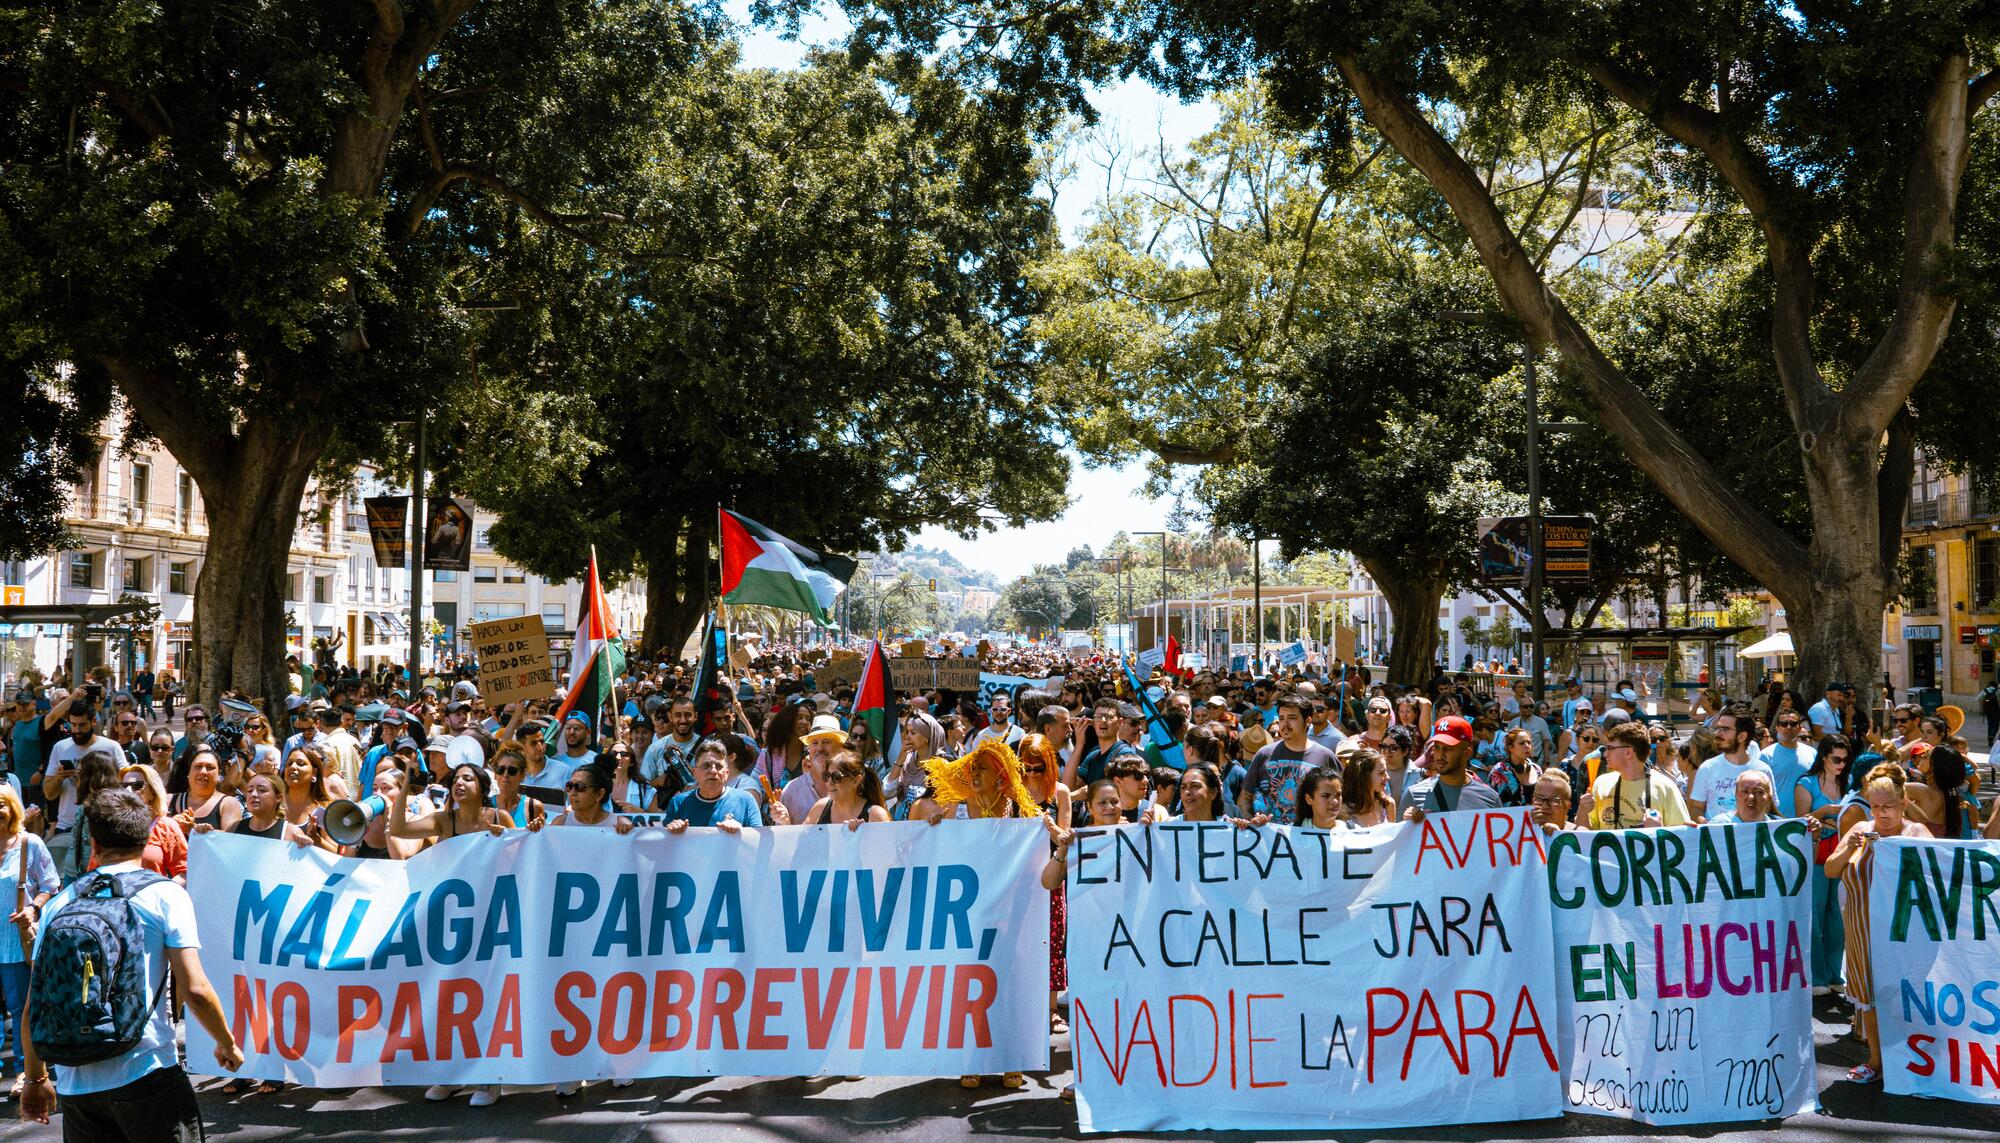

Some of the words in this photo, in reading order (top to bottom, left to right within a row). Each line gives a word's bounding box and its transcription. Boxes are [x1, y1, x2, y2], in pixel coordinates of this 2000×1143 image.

[1545, 532, 1589, 540] COSTURAS
[477, 625, 504, 639] HACIA
[508, 622, 524, 632] UN
[479, 642, 514, 658] MODELO
[516, 640, 529, 651] DE
[481, 658, 518, 673] CIUDAD
[485, 675, 513, 694] MENTE
[1438, 720, 1449, 731] NY
[1076, 822, 1374, 884] ENTERATE
[1414, 811, 1547, 875] AVRA
[1547, 820, 1808, 910] CORRALAS
[233, 873, 523, 971] MÁLAGA
[547, 870, 746, 958] PARA
[780, 863, 998, 960] VIVIR,
[1889, 846, 2000, 942] AVR
[1103, 912, 1146, 971] A
[1159, 907, 1331, 968] CALLE
[1371, 892, 1512, 960] JARA
[1569, 941, 1638, 1003] EN
[1653, 919, 1808, 999] LUCHA
[231, 974, 311, 1062] NO
[336, 973, 524, 1065] PARA
[549, 963, 999, 1057] SOBREVIVIR
[1074, 988, 1288, 1091] NADIE
[1300, 1013, 1355, 1071] LA
[1366, 984, 1560, 1084] PARA
[1575, 1005, 1625, 1059] ni
[1650, 1006, 1700, 1053] un
[1567, 1060, 1690, 1114] desahucio
[1715, 1032, 1786, 1116] más
